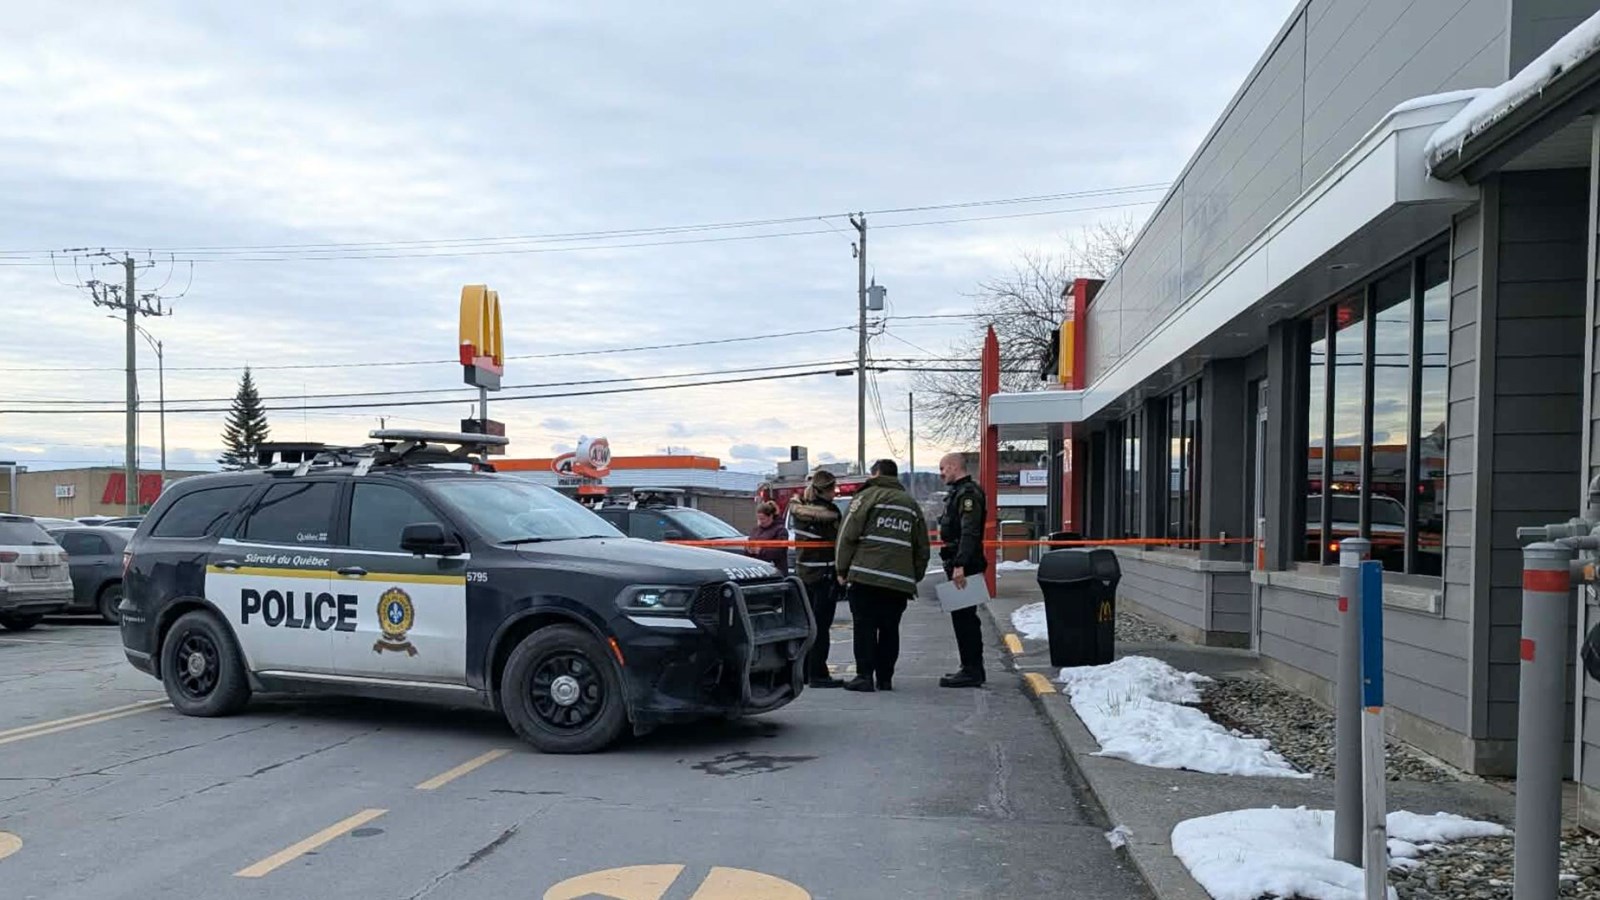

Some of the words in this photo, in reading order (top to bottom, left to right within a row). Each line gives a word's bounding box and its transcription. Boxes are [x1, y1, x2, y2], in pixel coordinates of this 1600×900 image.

[876, 516, 912, 532] POLIC
[244, 553, 276, 564] Sûreté
[277, 555, 291, 565] du
[292, 555, 330, 567] Québec
[466, 571, 488, 583] 5795
[241, 588, 358, 632] POLICE
